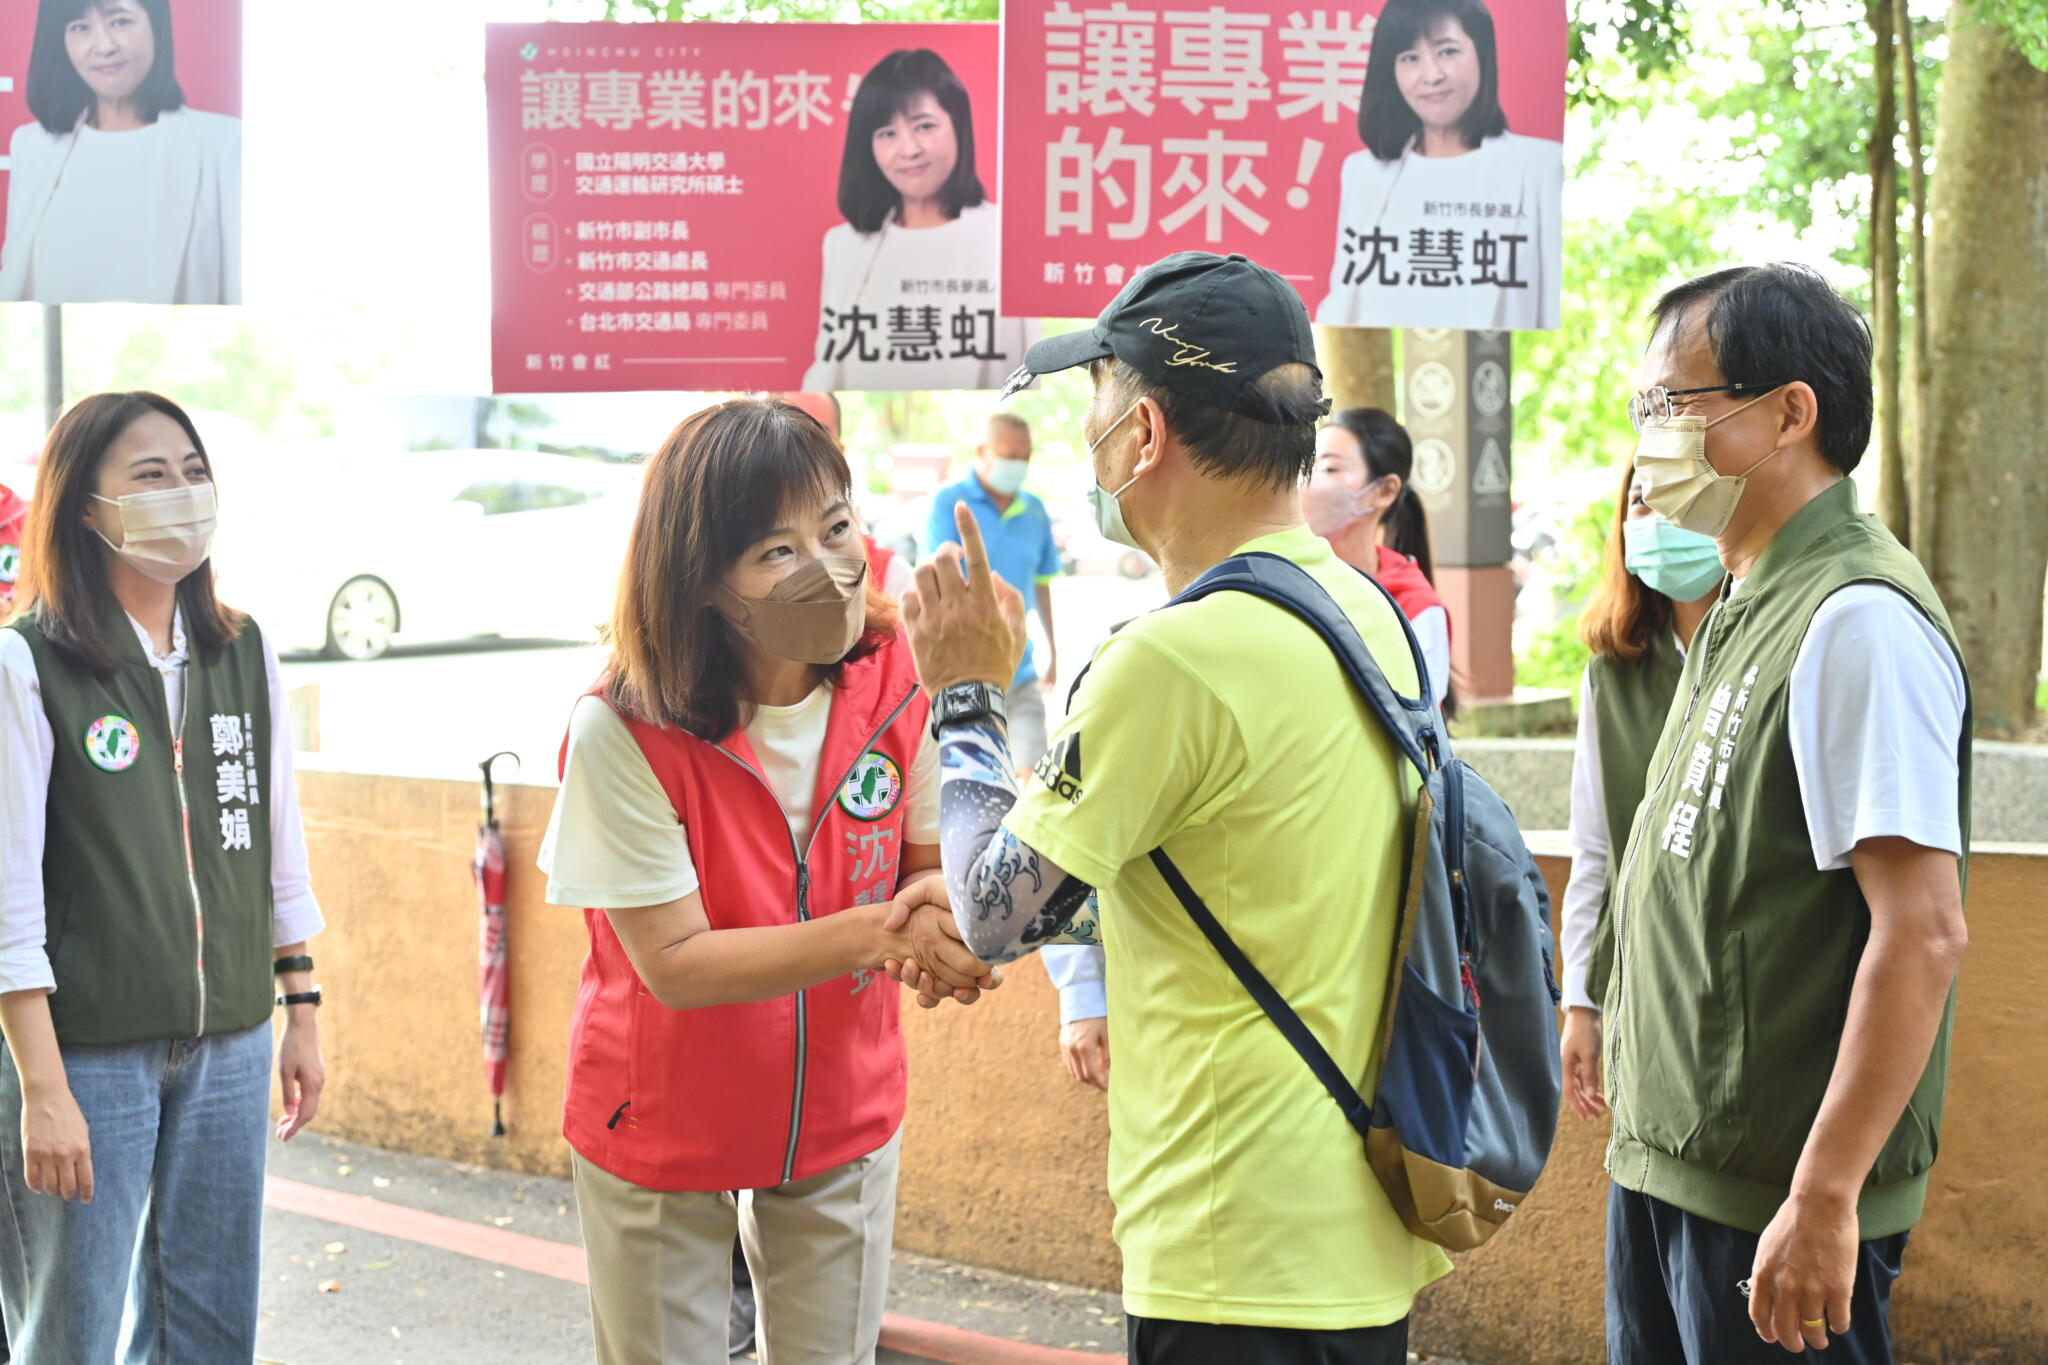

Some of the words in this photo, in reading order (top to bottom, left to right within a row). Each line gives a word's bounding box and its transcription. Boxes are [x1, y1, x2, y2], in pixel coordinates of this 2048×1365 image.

[547, 46, 641, 58] HSINCHU
[654, 46, 702, 58] CITY
[1043, 1, 1376, 123] 讓專業
[575, 151, 727, 172] 國立陽明交通大學
[575, 175, 744, 195] 交通運輸研究所碩士
[1043, 125, 1325, 243] 的來!
[576, 220, 690, 241] 新竹市副市長
[577, 251, 709, 272] 新竹市交通處長
[1341, 226, 1529, 289] 沈慧虹
[1042, 261, 1152, 286] 新竹會
[579, 311, 692, 332] 台北市交通局
[822, 304, 1007, 362] 沈慧虹
[209, 713, 252, 851] 鄭美娟
